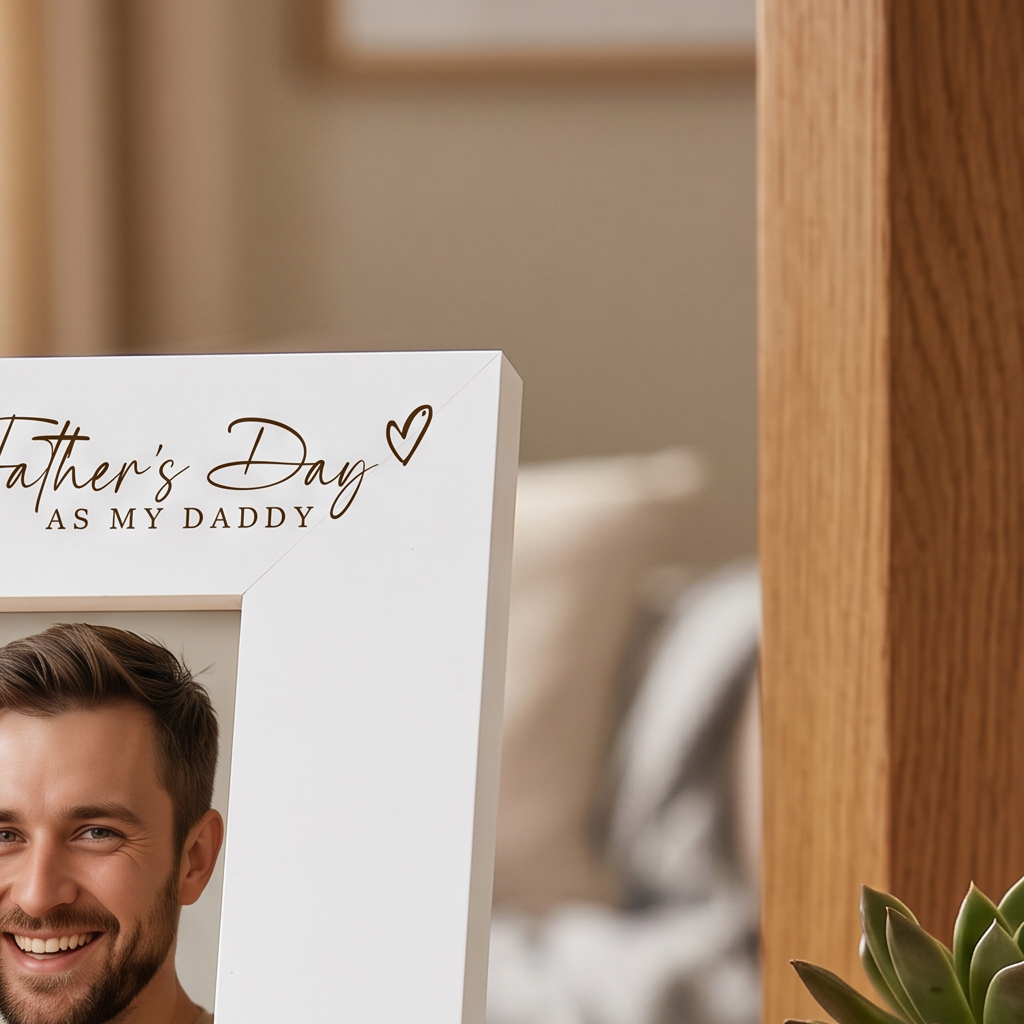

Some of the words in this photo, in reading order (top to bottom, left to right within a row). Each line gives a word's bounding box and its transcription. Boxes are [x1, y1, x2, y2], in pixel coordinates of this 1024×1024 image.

[206, 416, 379, 520] Day
[45, 507, 89, 530] AS
[109, 507, 164, 530] MY
[182, 505, 315, 529] DADDY
